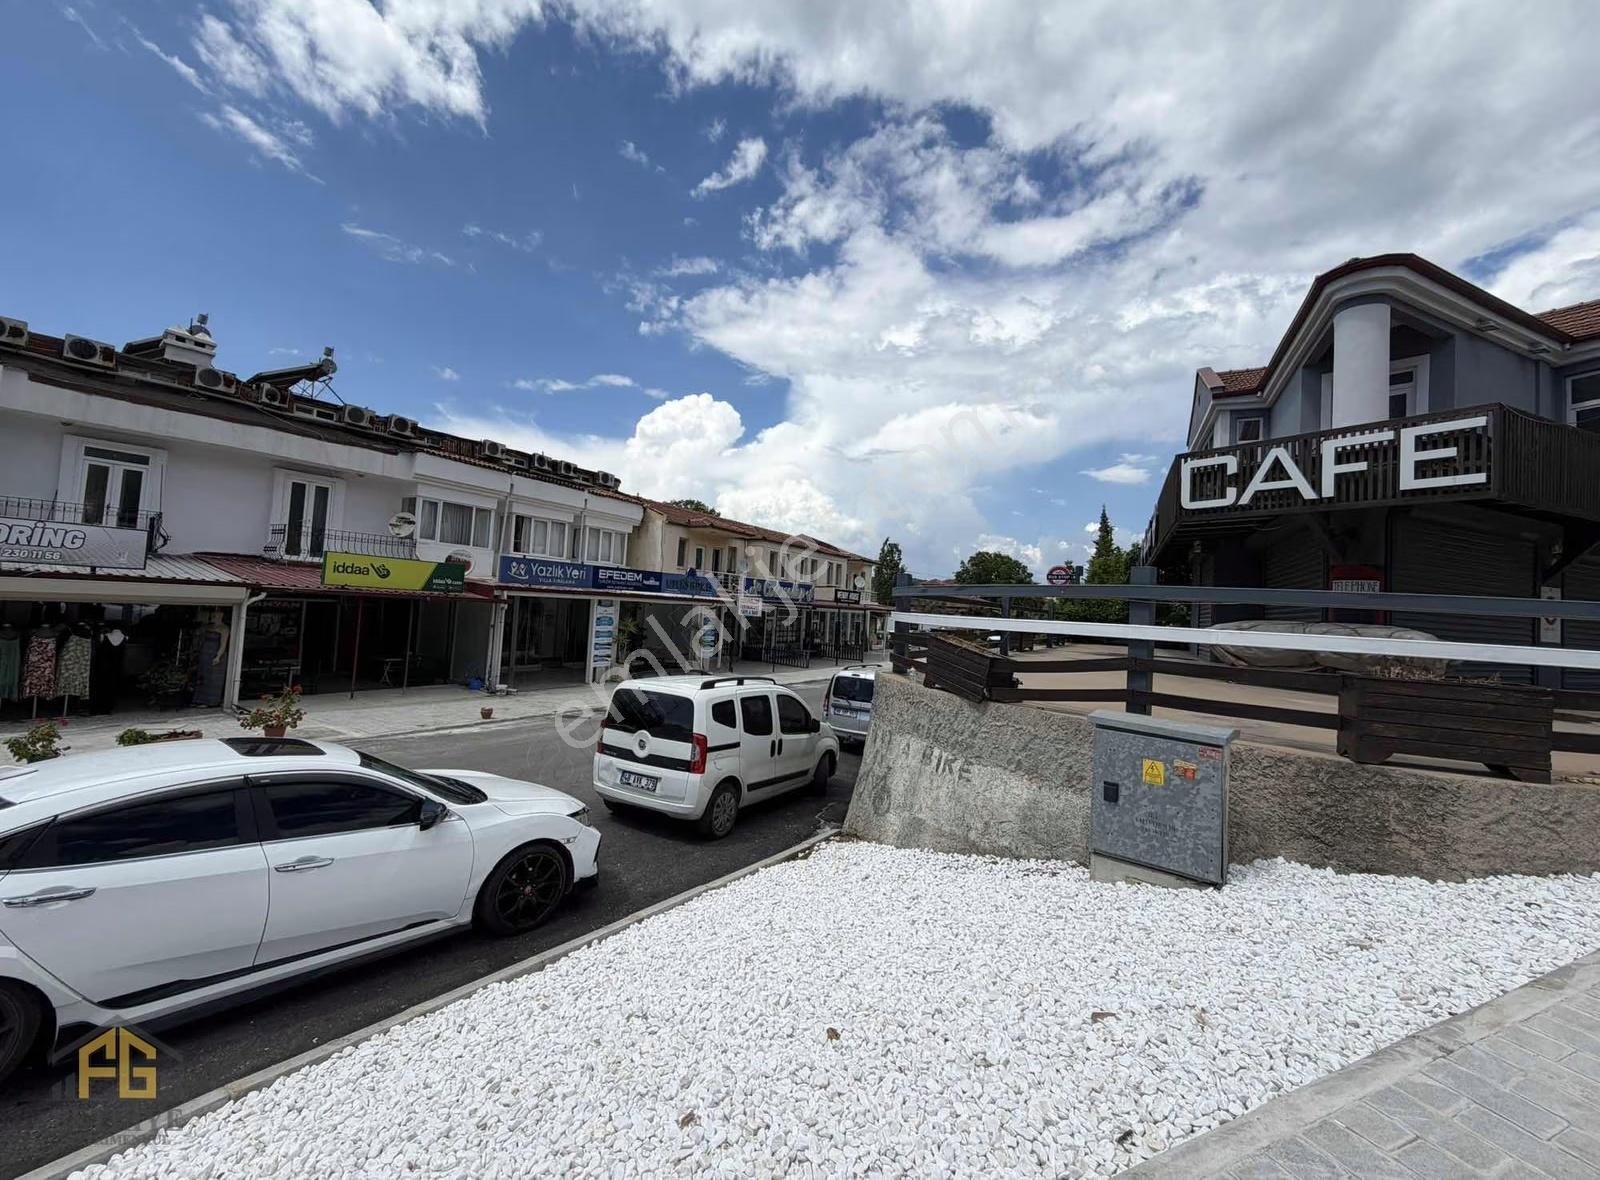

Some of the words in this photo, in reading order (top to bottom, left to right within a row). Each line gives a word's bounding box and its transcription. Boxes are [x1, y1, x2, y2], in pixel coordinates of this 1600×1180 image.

[1180, 416, 1488, 510] CAFE
[2, 549, 28, 558] 230
[32, 550, 42, 559] 11
[332, 561, 370, 576] iddaa
[530, 563, 564, 579] Yazlık
[566, 566, 587, 580] Yeri
[598, 569, 643, 582] EFEDEM
